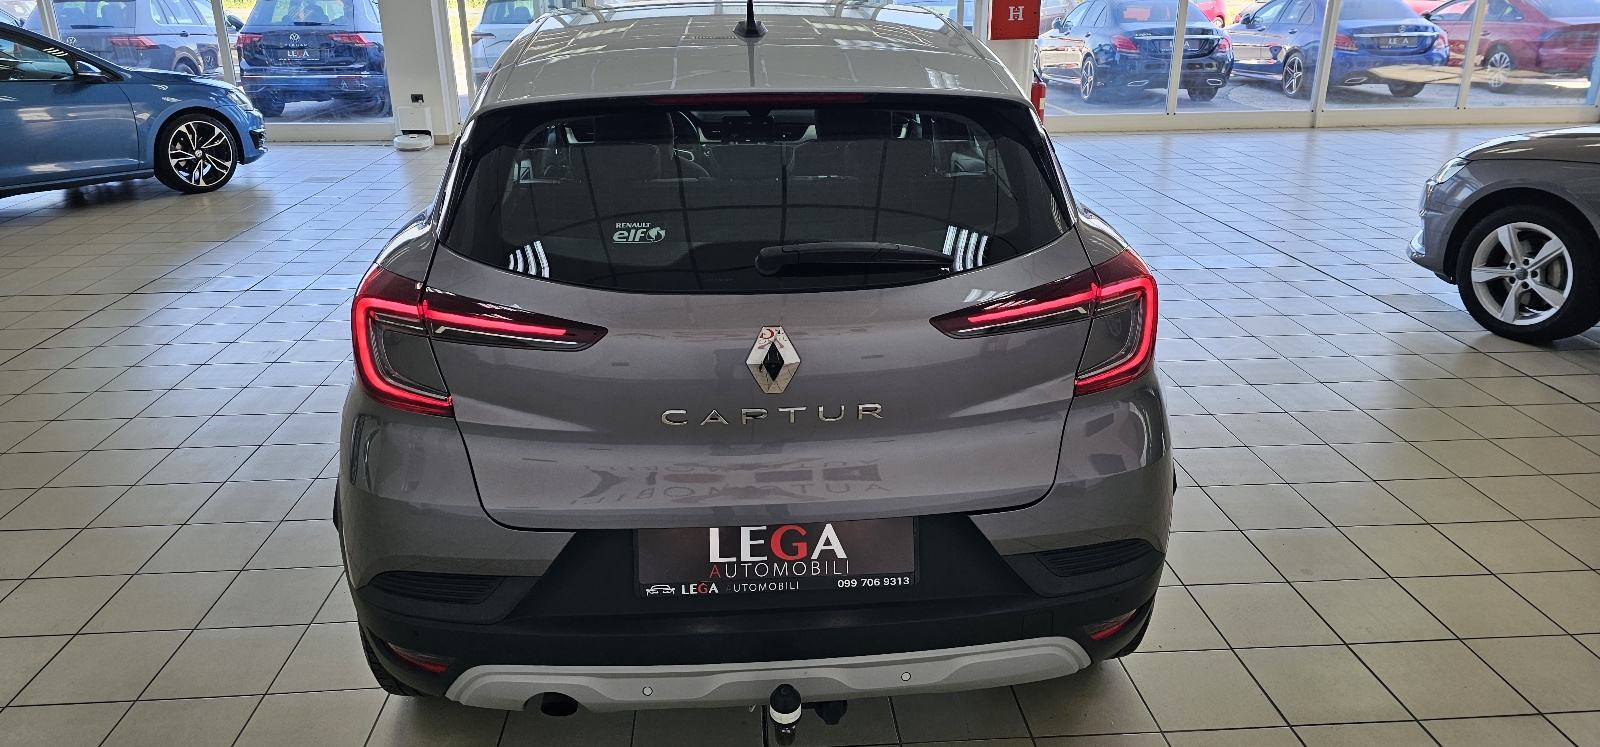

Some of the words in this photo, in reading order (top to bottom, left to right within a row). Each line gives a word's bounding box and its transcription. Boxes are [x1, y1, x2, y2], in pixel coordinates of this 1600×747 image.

[661, 403, 884, 426] CAPTUR
[709, 523, 848, 562] LEGA
[709, 560, 849, 578] AUTOMOBILI
[681, 582, 719, 595] LEGA
[837, 579, 858, 588] 099
[861, 578, 881, 587] 706
[883, 576, 910, 586] 9313
